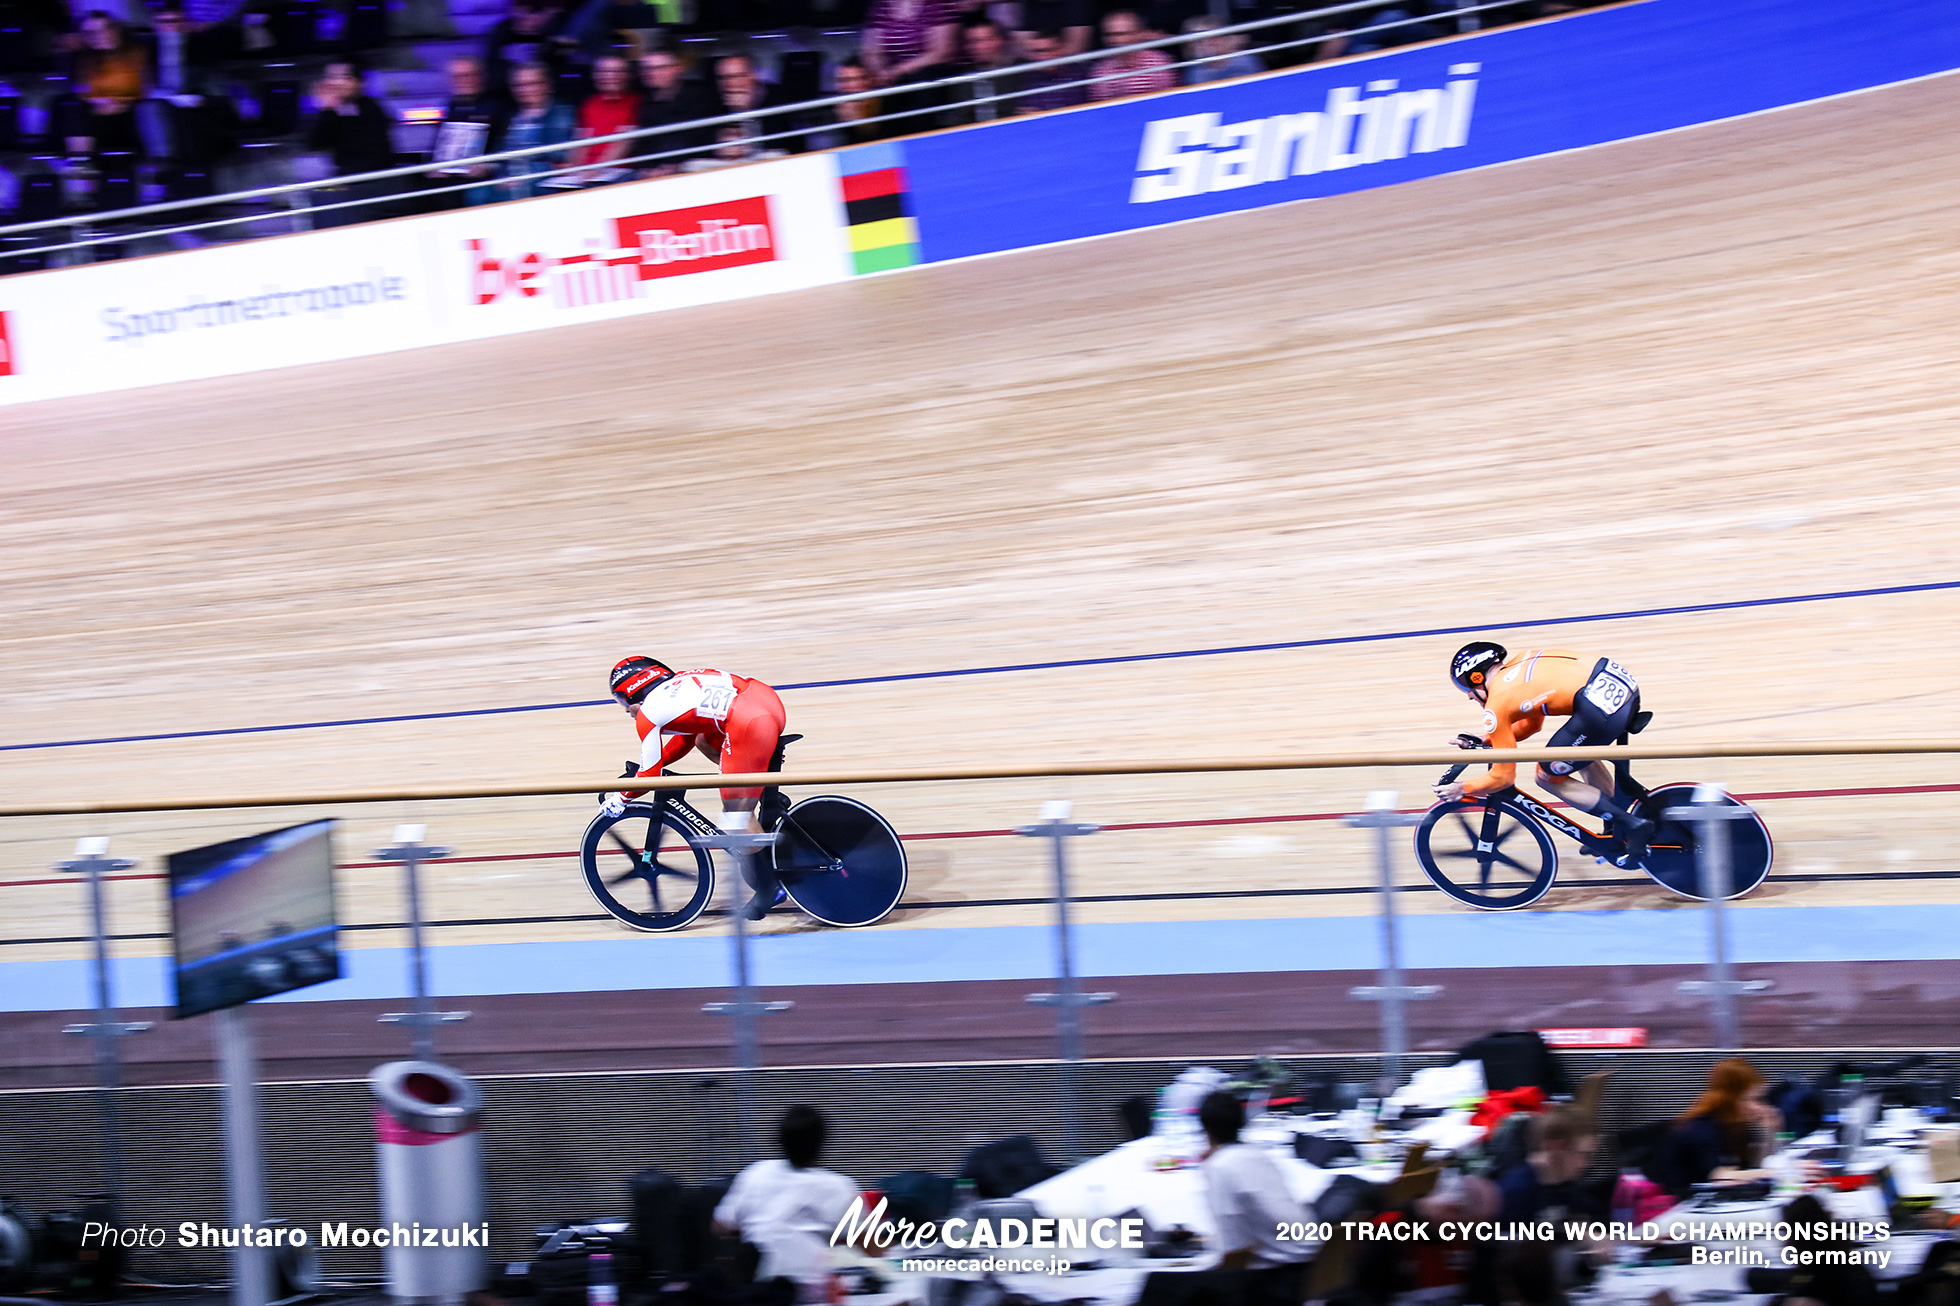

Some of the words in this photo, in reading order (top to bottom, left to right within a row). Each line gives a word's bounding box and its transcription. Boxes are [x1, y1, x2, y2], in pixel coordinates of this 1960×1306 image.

[1129, 62, 1482, 203] Santini
[636, 217, 771, 265] Berlin
[1455, 649, 1495, 678] LAZER
[700, 687, 732, 712] 261
[1594, 678, 1625, 707] 288
[666, 797, 720, 836] BRIDGES
[1513, 794, 1581, 839] KOGA
